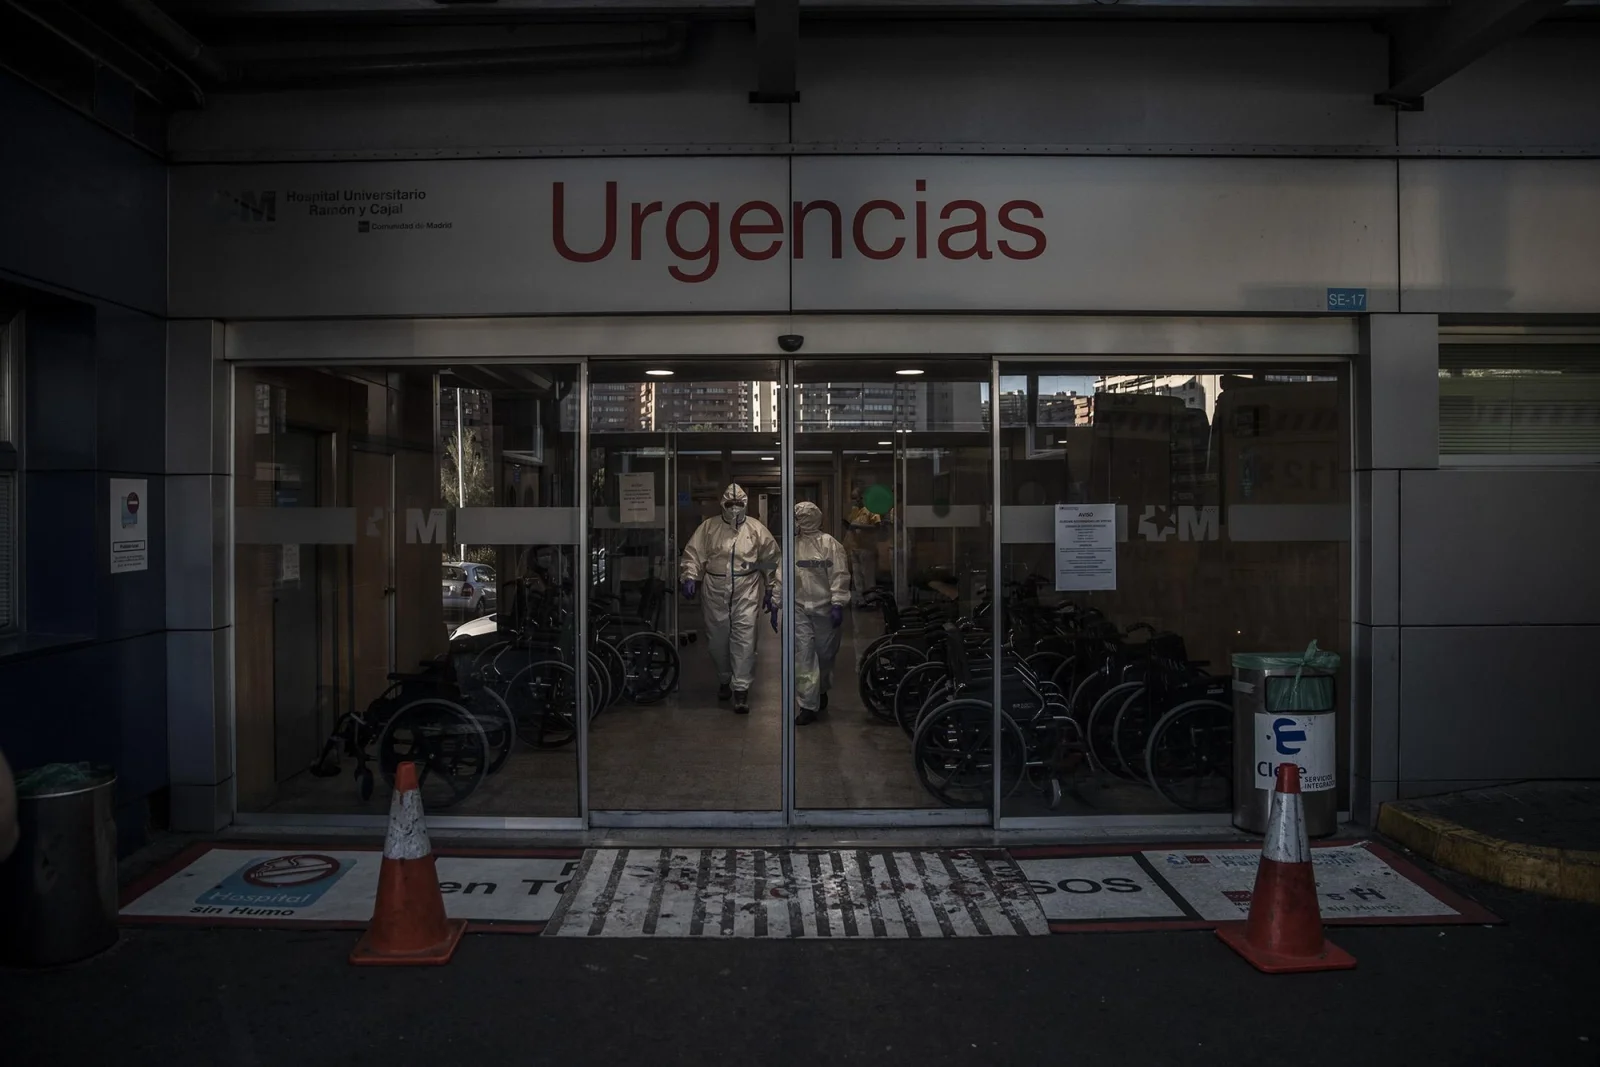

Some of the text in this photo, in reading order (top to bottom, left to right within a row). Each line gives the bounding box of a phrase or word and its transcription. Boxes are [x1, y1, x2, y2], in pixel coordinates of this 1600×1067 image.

[286, 188, 427, 203] Hospital Universitario
[308, 203, 403, 217] Ramón y Cajal
[371, 222, 414, 230] Comunidad
[426, 221, 453, 229] Madrid
[552, 179, 1047, 283] Urgencias
[1328, 293, 1365, 306] SE-17
[406, 508, 447, 544] M
[1178, 505, 1219, 541] M
[1257, 761, 1307, 779] Clee
[1304, 773, 1332, 783] SERVICIOS
[1215, 853, 1258, 861] Hospit
[439, 881, 497, 894] en
[208, 891, 313, 905] Hospital
[189, 905, 295, 916] sin Humo
